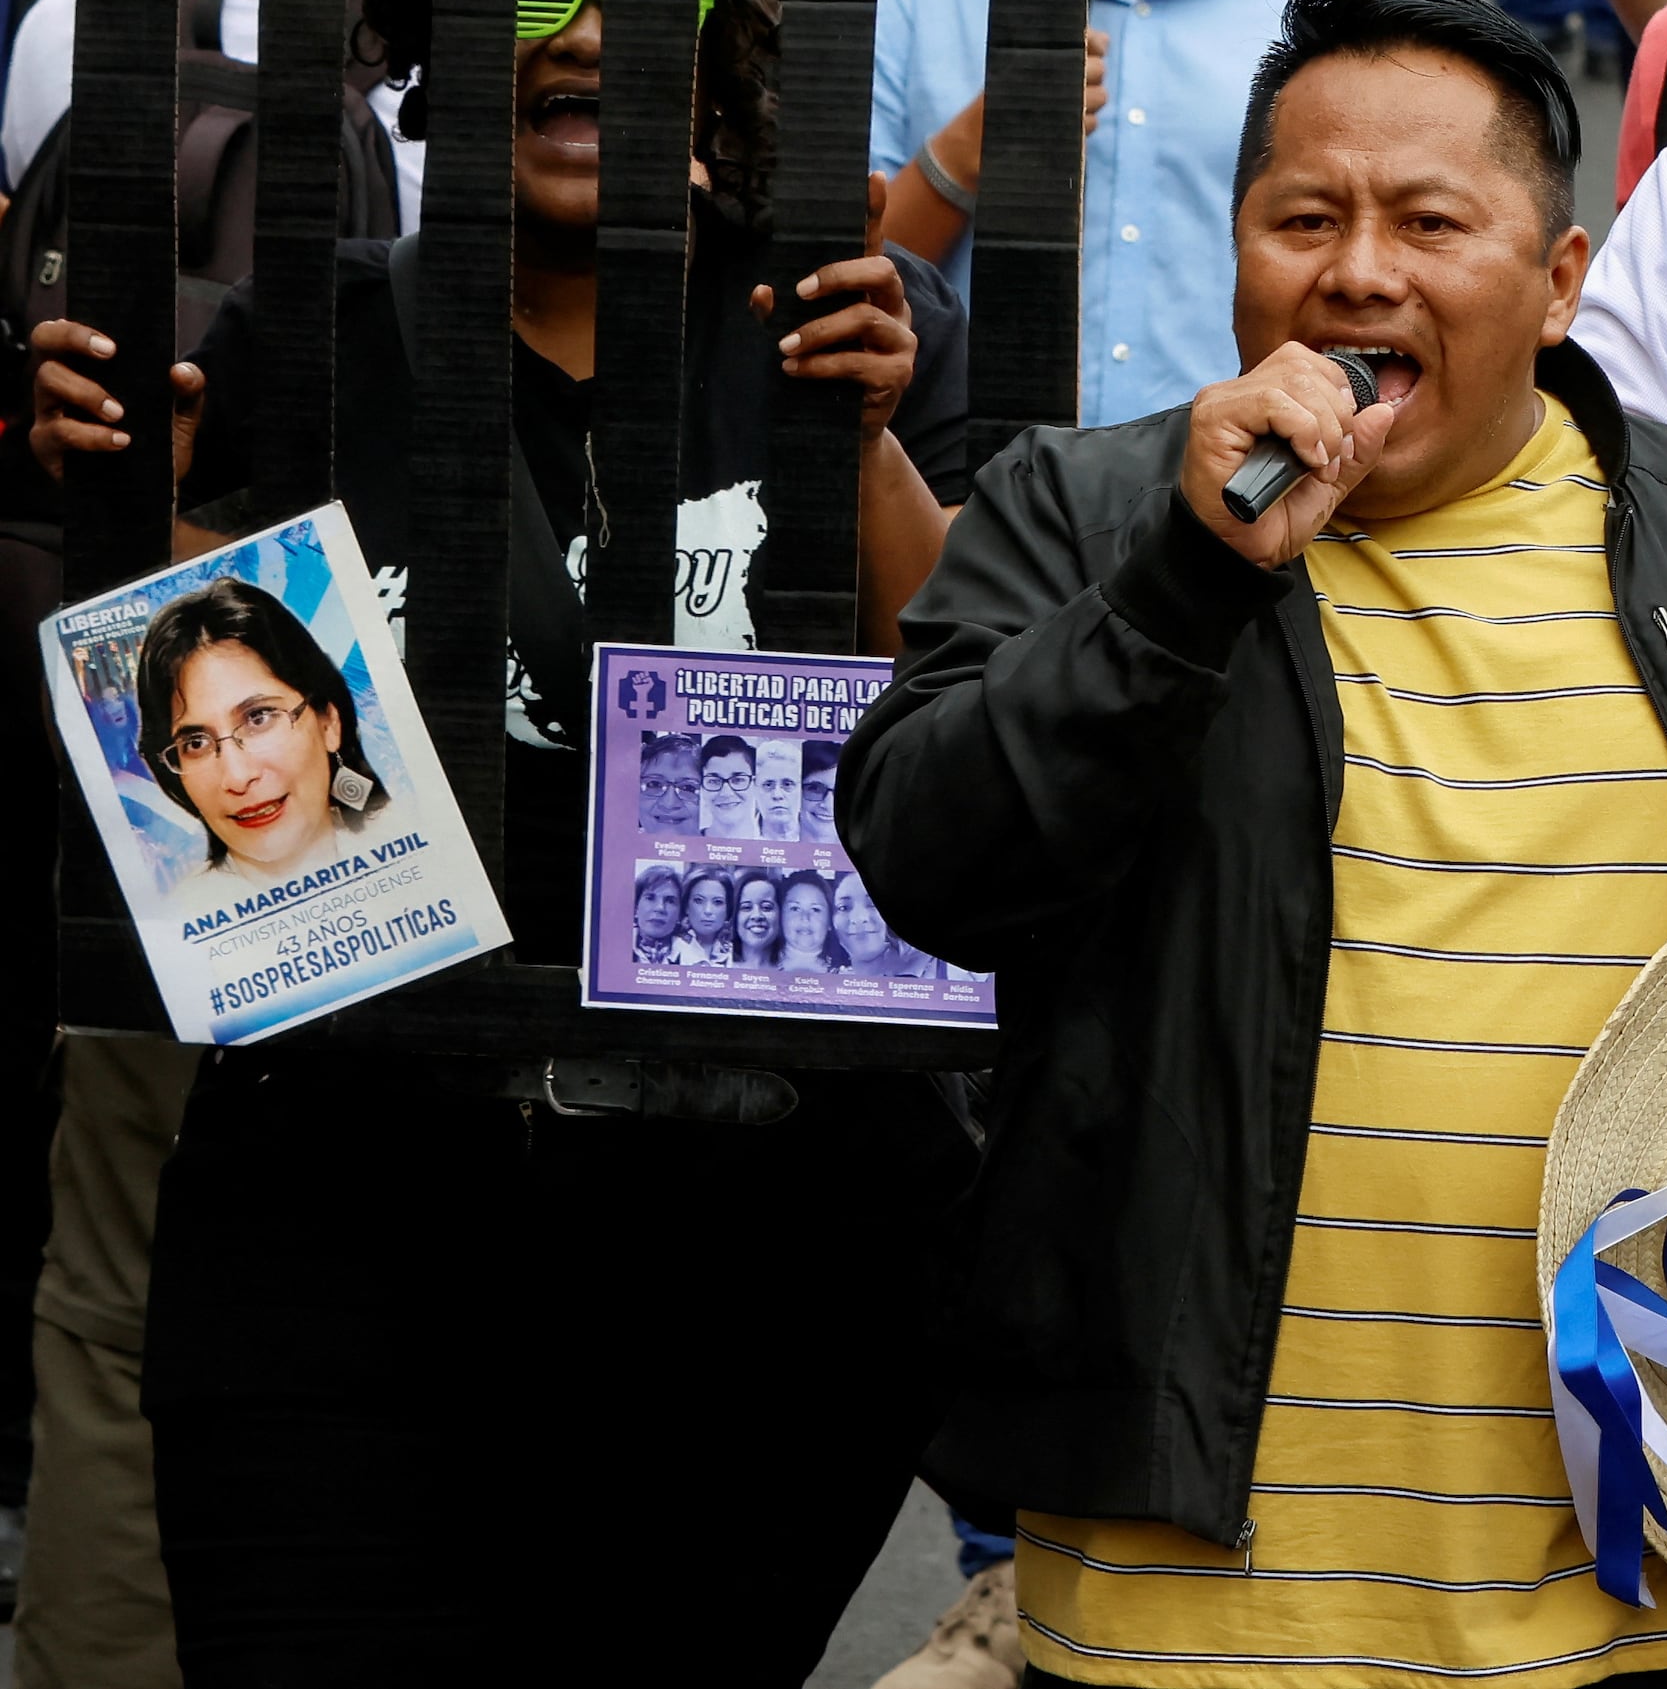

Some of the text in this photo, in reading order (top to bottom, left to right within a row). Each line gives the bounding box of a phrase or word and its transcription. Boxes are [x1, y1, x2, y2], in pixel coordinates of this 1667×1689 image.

[60, 601, 149, 635] LIBERTAD
[676, 668, 785, 700] ¡LIBERTAD
[792, 678, 849, 703] PARA
[687, 696, 799, 729] POLÍTICAS
[805, 706, 835, 731] DE
[706, 843, 743, 853] Tamara
[182, 832, 429, 940] ANA MARGARITA VIJIL
[208, 865, 424, 961] ACTIVISTA NICARAGÜENSE
[276, 910, 368, 957] 43 AÑOS
[209, 898, 458, 1016] #SOSPRESASPOLITÍCAS
[843, 979, 879, 988] Cristina
